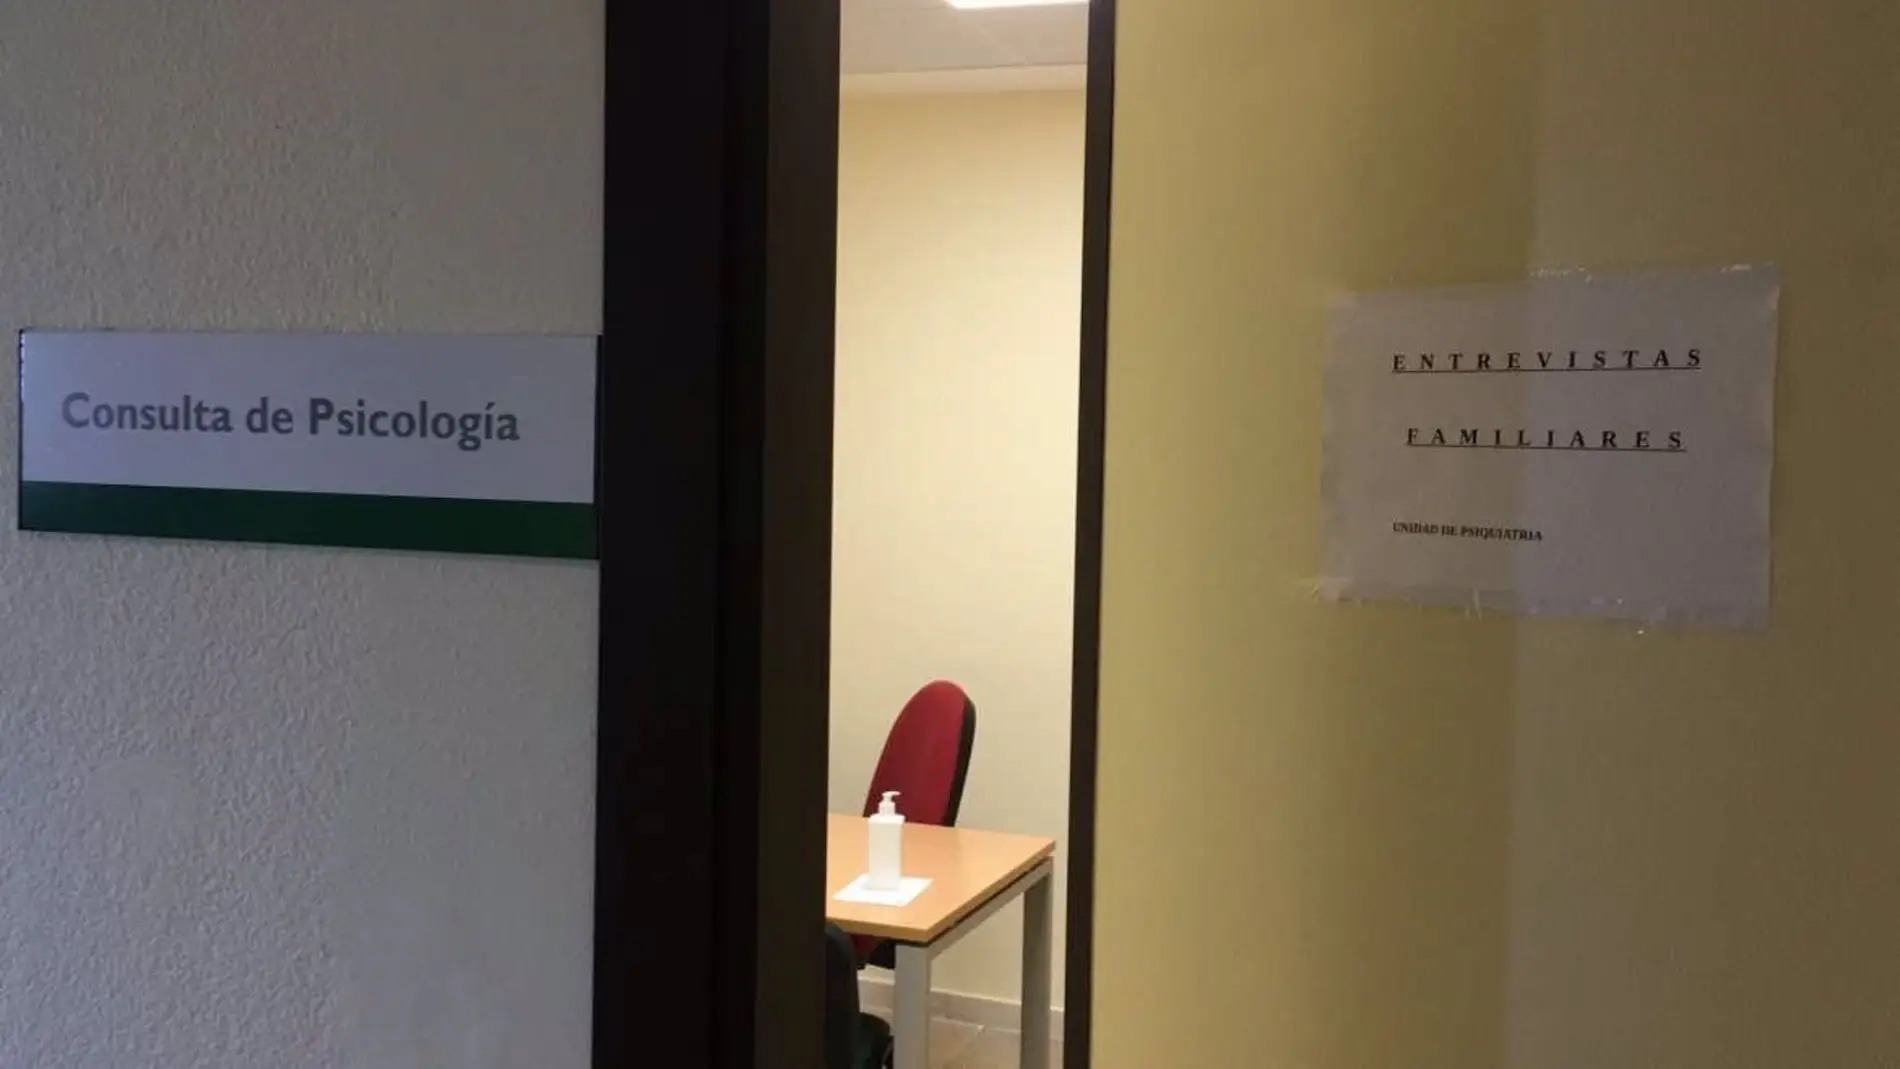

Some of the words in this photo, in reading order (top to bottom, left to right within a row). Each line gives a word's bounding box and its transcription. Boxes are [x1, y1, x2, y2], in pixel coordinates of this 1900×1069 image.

[1393, 348, 1702, 371] ENTREVISTAS
[61, 392, 233, 434] Consulta
[245, 397, 294, 434] de
[308, 397, 520, 451] Psicología
[1407, 427, 1684, 450] FAMILIARES
[1392, 521, 1439, 534] UNIDAD
[1441, 525, 1458, 536] DE
[1460, 526, 1543, 541] PSIQUIATRIA
